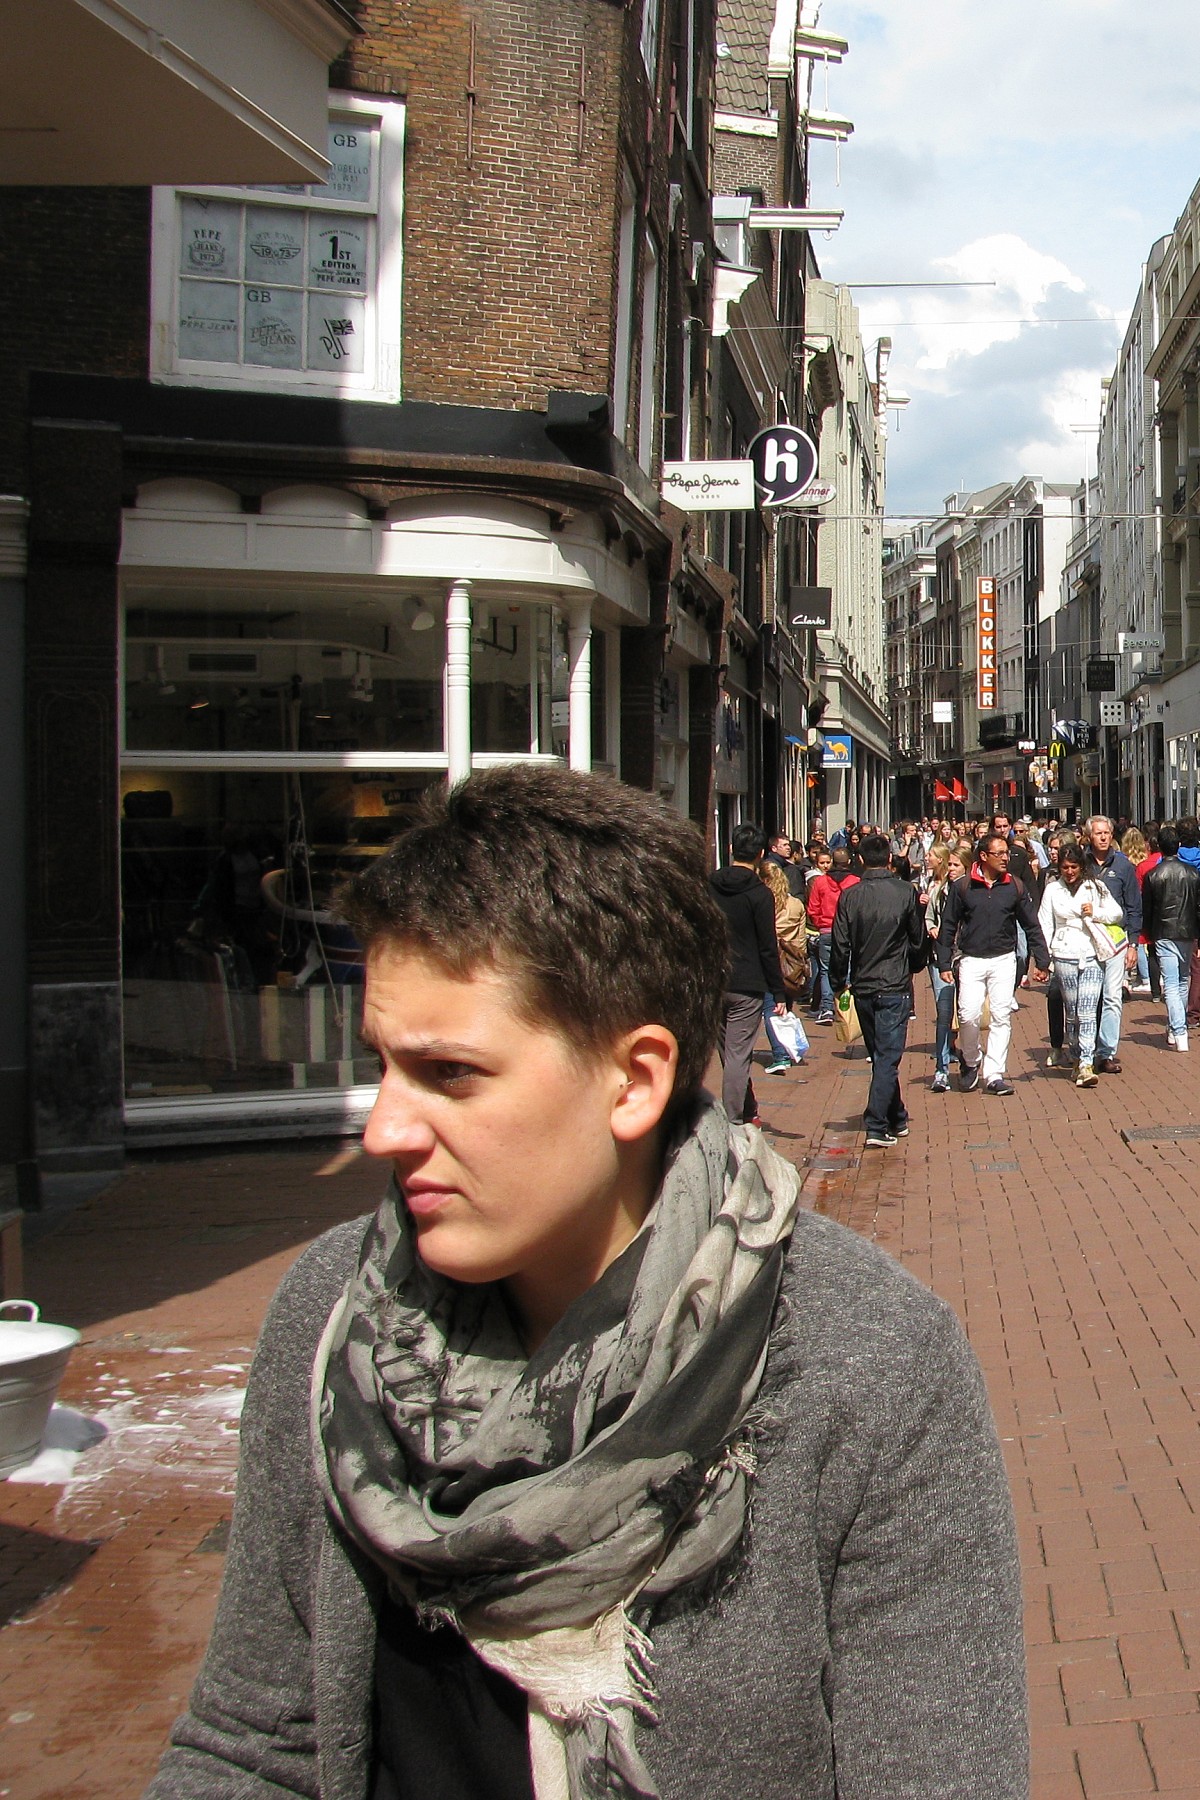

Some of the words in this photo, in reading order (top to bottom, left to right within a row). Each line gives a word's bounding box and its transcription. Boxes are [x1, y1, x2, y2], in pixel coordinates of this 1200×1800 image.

[333, 134, 358, 148] GB
[321, 260, 357, 270] EDITION
[337, 276, 361, 286] JEANS
[247, 289, 272, 303] GB
[764, 438, 798, 483] hi
[670, 473, 701, 493] Pepe
[701, 474, 741, 493] Jeans
[791, 614, 827, 626] Clarks
[980, 579, 995, 707] BLOKKER
[1122, 638, 1161, 649] Bershka
